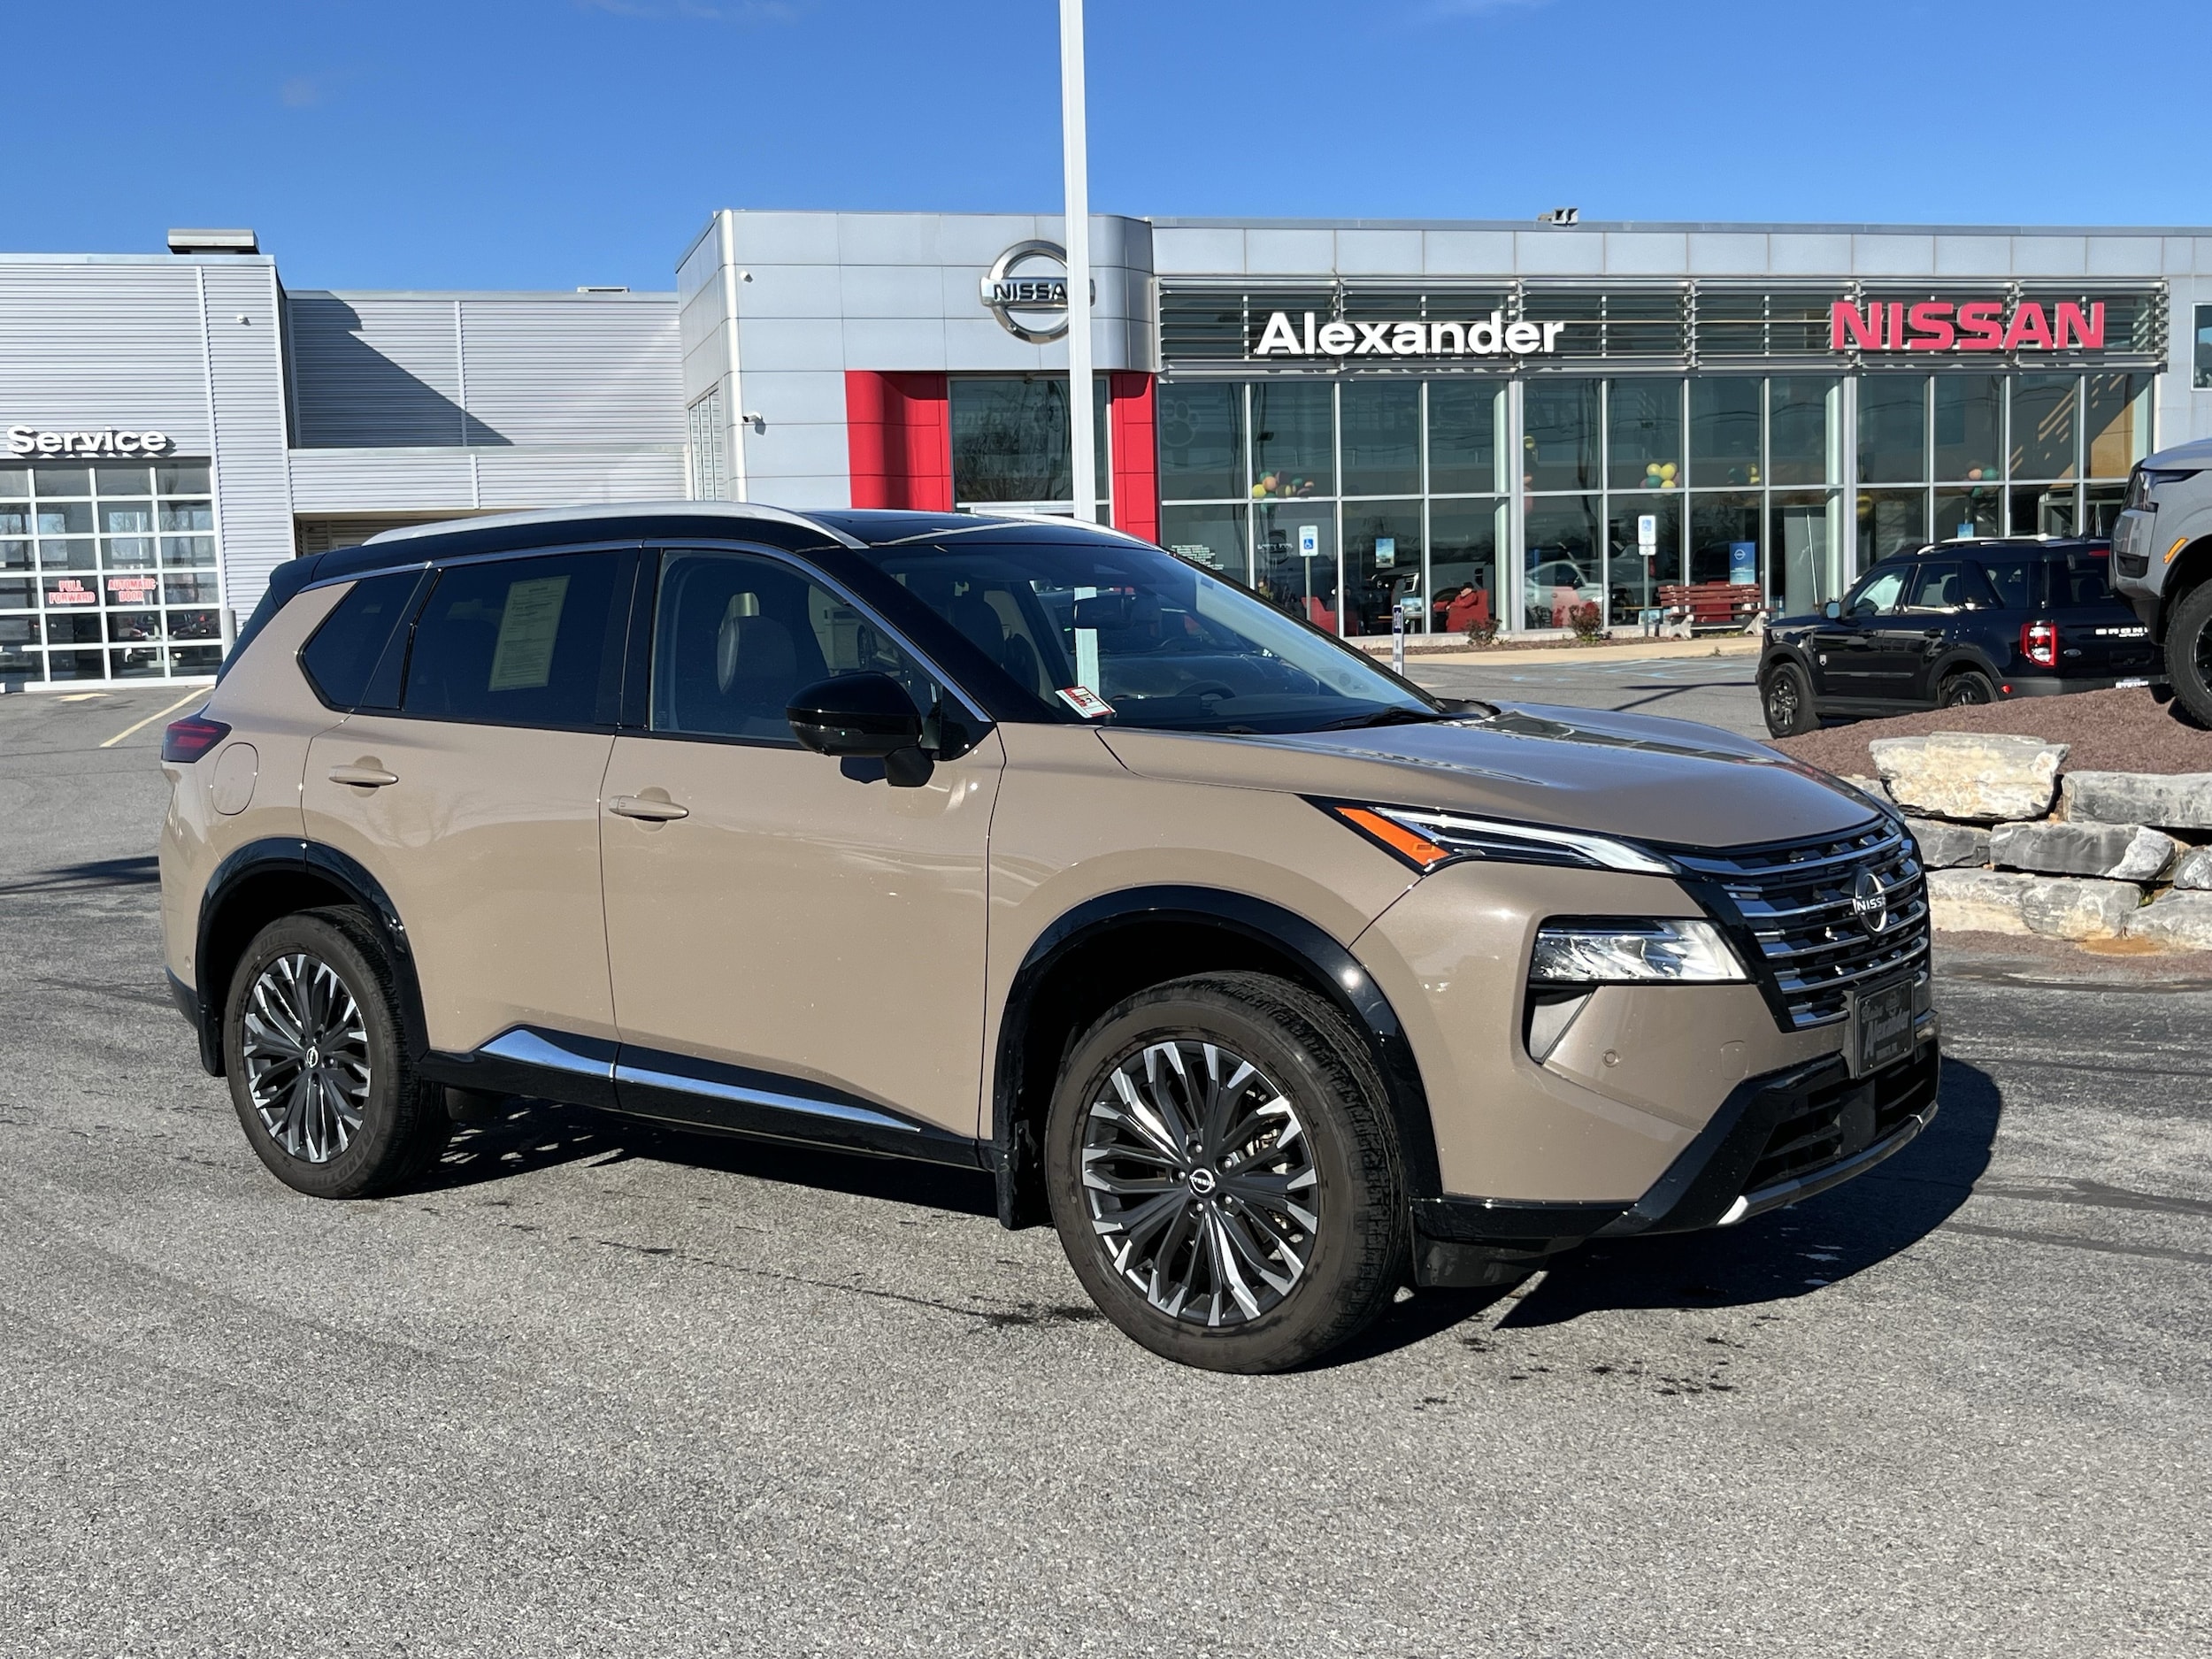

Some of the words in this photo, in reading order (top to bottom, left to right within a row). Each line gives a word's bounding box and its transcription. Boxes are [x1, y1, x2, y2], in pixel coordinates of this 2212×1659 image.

[994, 282, 1068, 301] NISSA
[1255, 311, 1564, 355] Alexander
[1831, 302, 2105, 349] NISSAN
[6, 425, 167, 453] Service
[58, 580, 84, 592] PULL
[108, 578, 157, 591] AUTOMATIC
[49, 592, 96, 603] FORWARD
[119, 590, 144, 602] DOOR
[1856, 896, 1886, 911] NISS
